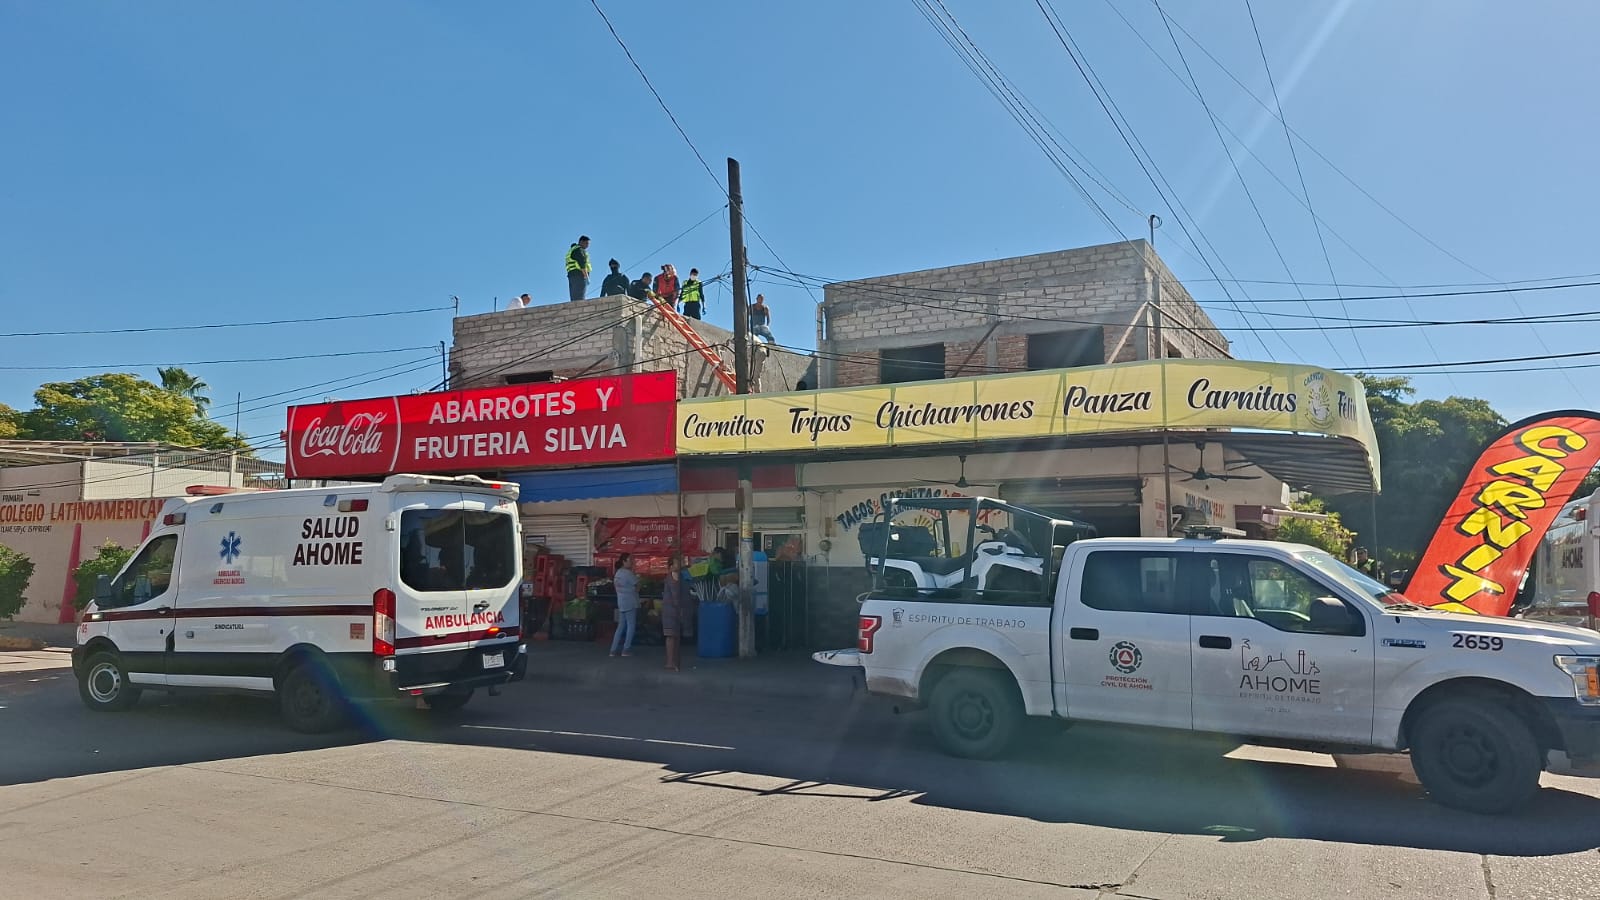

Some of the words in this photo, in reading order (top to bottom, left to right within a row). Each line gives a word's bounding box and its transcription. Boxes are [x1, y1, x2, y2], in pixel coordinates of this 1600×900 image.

[429, 391, 576, 425] ABARROTES
[595, 387, 615, 412] Y
[684, 413, 765, 439] Carnitas
[789, 407, 852, 442] Tripas
[876, 400, 1035, 429] Chicharrones
[1063, 385, 1152, 416] Panza
[1188, 378, 1297, 413] Carnitas
[300, 411, 388, 458] Coca-Cola
[414, 431, 530, 460] FRUTERIA
[544, 424, 627, 452] SILVIA
[0, 503, 45, 523] COLEGIO
[837, 498, 874, 530] TACOS
[301, 517, 359, 539] SALUD
[293, 542, 363, 566] AHOME
[425, 610, 505, 629] AMBULANCIA
[909, 614, 954, 624] ESPIRITU
[958, 617, 972, 625] DE
[976, 617, 1026, 628] TRABAJO
[1452, 633, 1504, 651] 2659
[1240, 675, 1321, 695] AHOME
